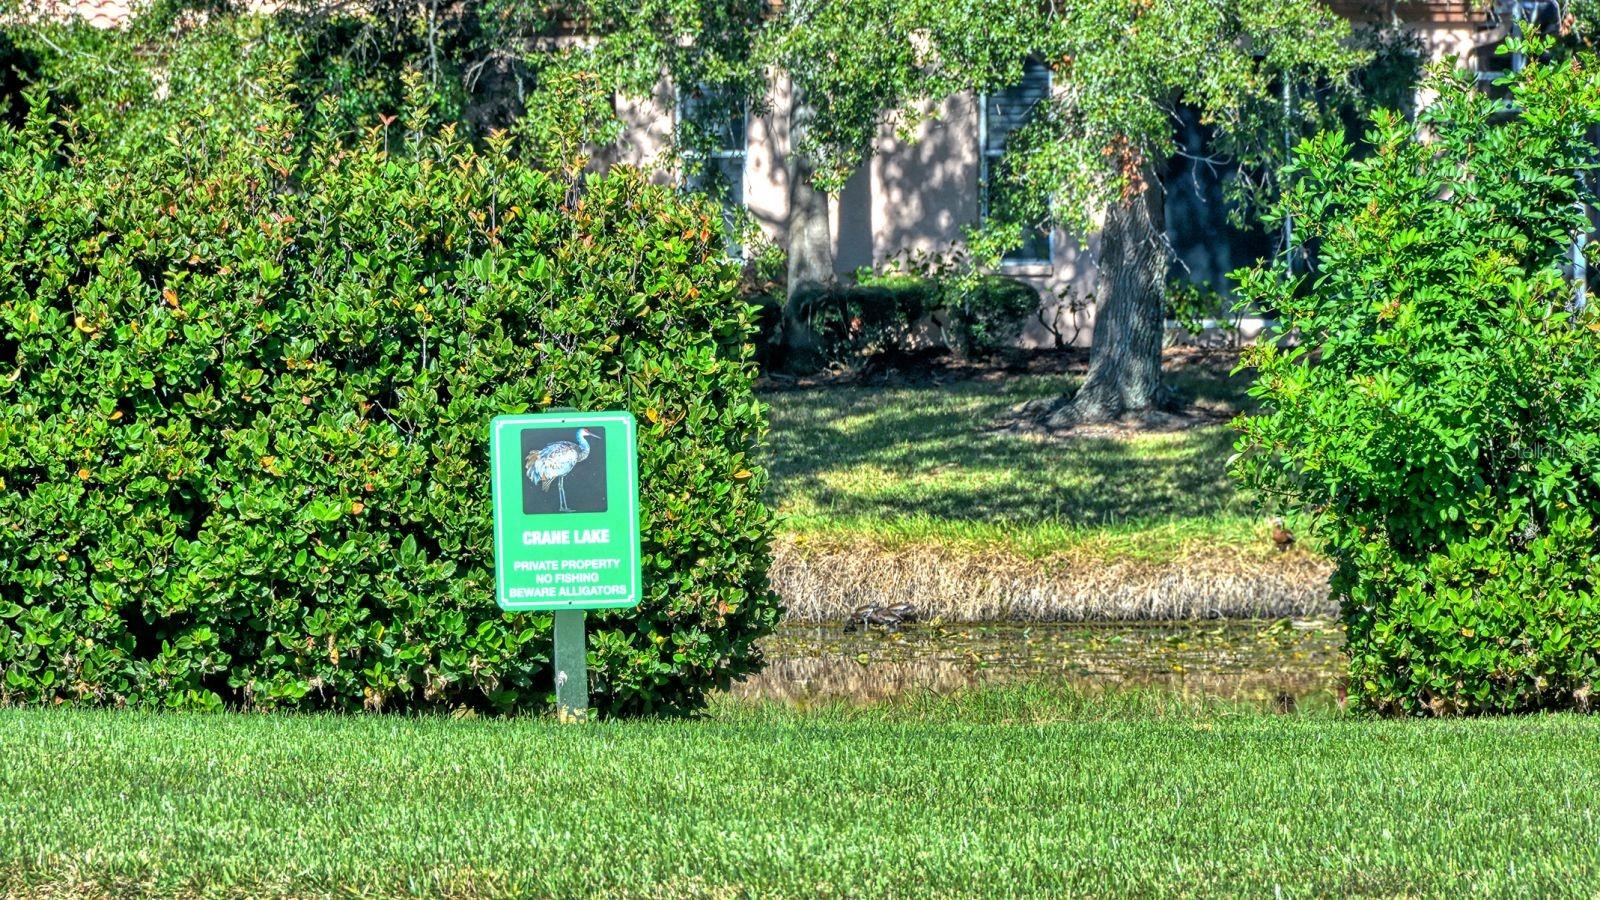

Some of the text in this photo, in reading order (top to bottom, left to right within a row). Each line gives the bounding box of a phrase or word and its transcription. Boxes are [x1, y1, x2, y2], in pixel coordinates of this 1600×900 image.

[522, 529, 610, 544] CRANE LAKE
[513, 559, 621, 571] PRIVATE PROPERTY
[536, 572, 599, 584] NO FISHING
[509, 585, 627, 598] BEWARE ALLIGATORS
